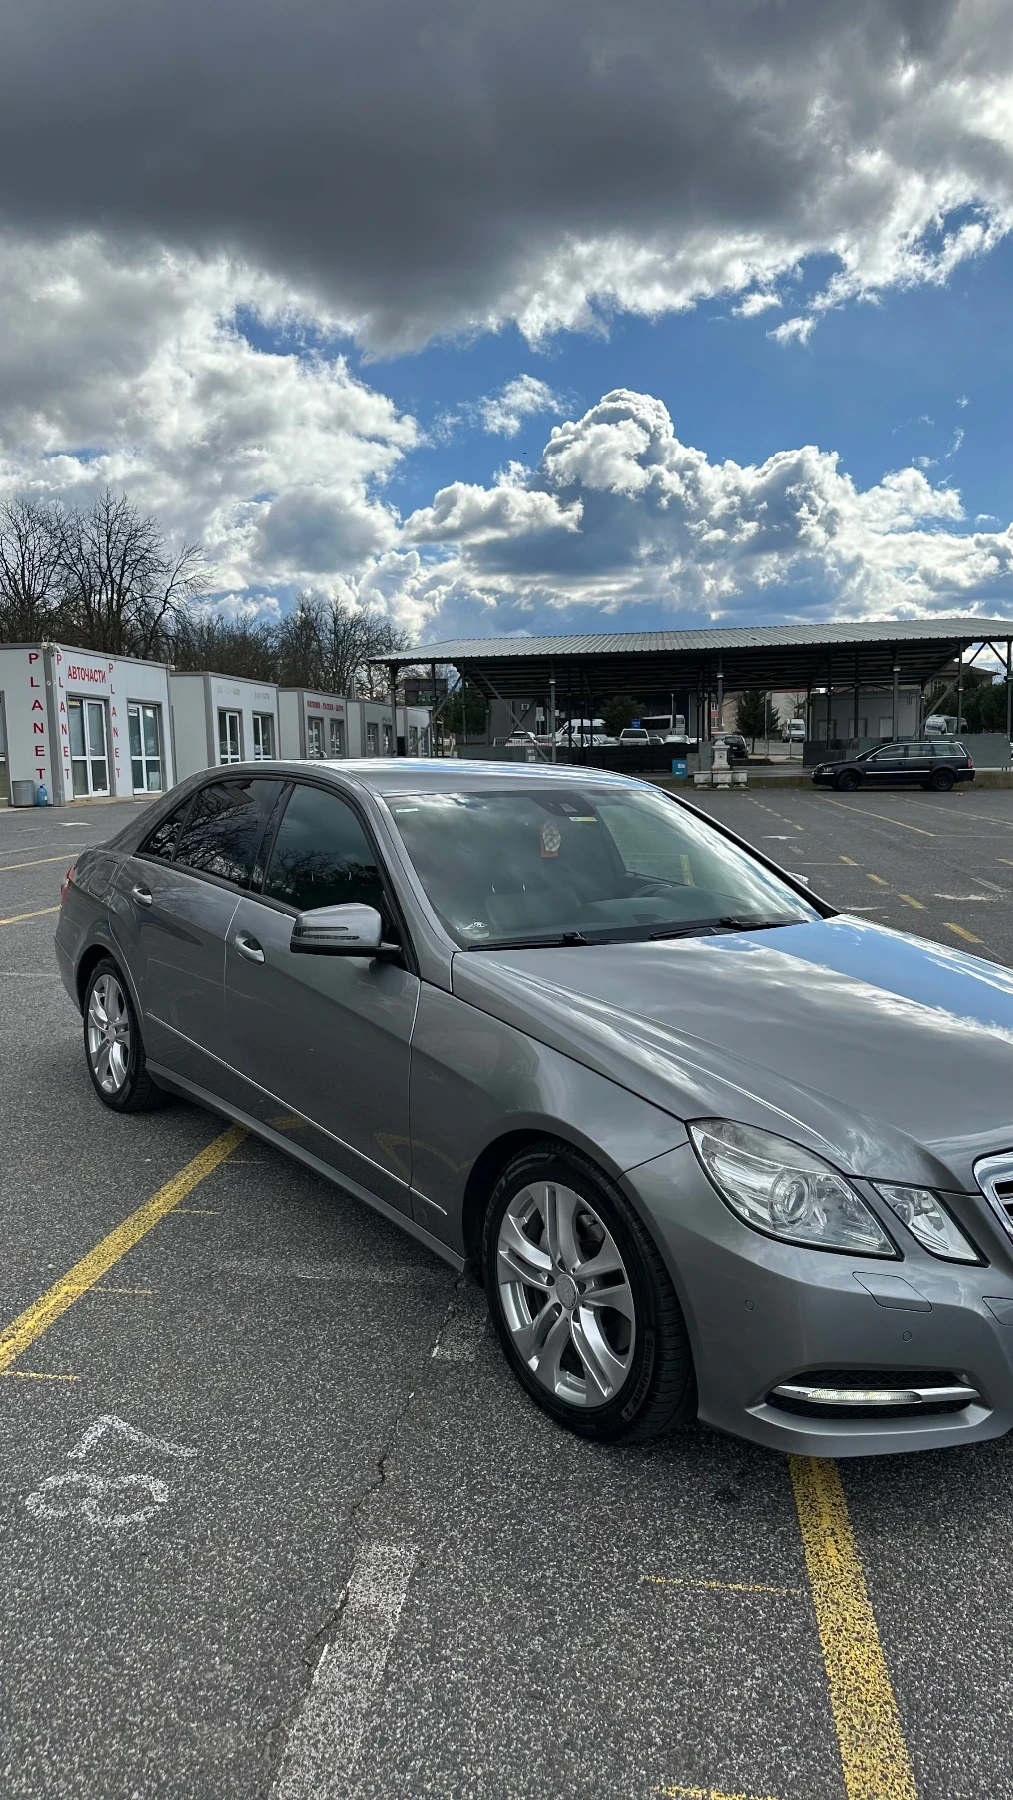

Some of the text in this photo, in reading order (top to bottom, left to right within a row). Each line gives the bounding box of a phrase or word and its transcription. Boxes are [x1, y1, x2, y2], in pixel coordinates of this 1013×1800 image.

[28, 653, 46, 779] PLANET
[56, 654, 70, 780] PLANET
[67, 665, 107, 684] АВТОЧАСТИ
[108, 663, 121, 778] PLANET
